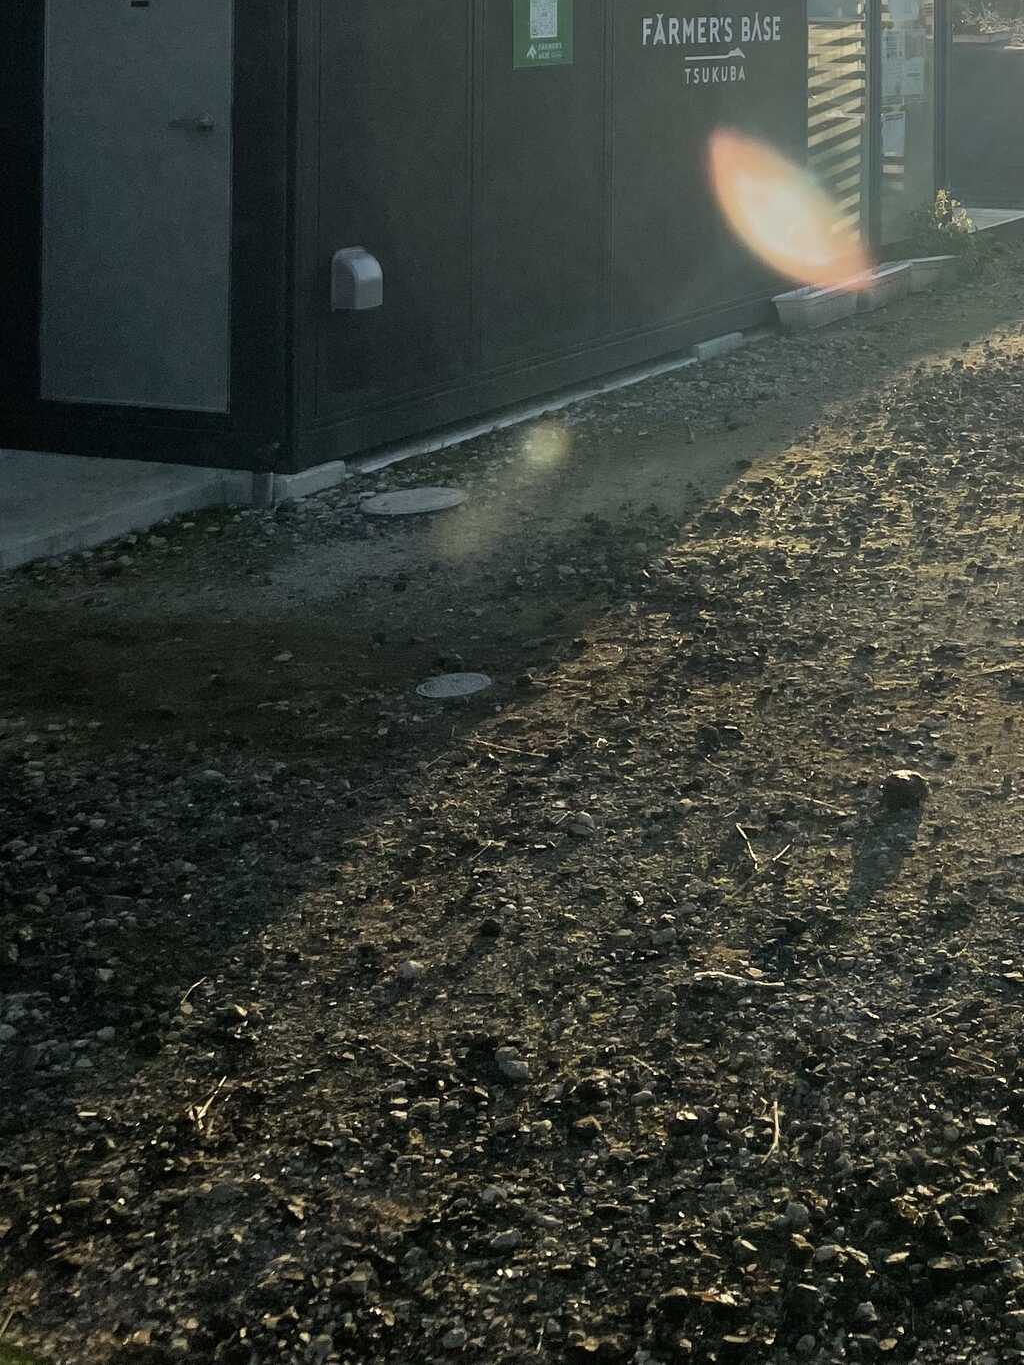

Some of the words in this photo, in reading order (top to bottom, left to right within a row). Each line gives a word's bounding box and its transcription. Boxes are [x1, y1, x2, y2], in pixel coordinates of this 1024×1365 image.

[642, 13, 733, 45] FARMER'S
[741, 12, 781, 42] BASE
[684, 66, 746, 84] TSUKUBA
